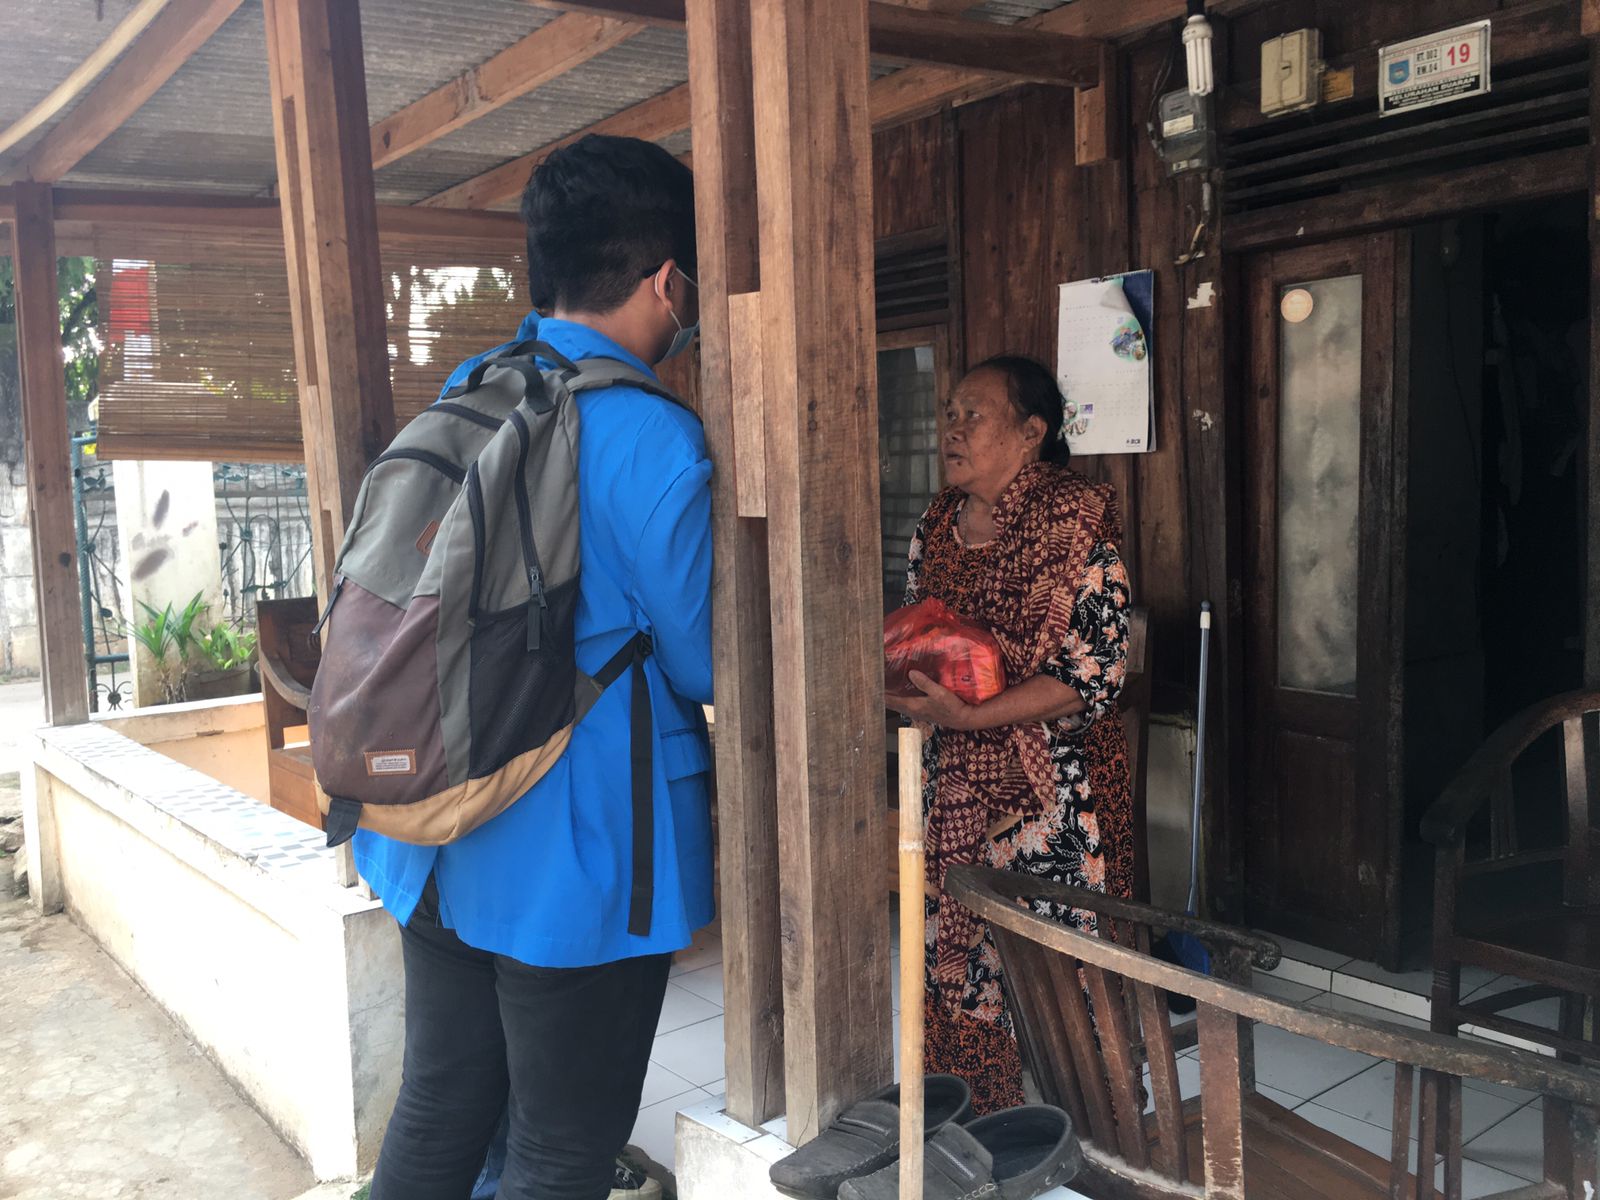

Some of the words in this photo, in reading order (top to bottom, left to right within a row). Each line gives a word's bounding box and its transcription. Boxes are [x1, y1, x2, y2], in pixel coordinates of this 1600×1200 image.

[1447, 43, 1470, 66] 19
[1388, 86, 1440, 102] KELURAHAN
[1440, 77, 1476, 90] BUARAN
